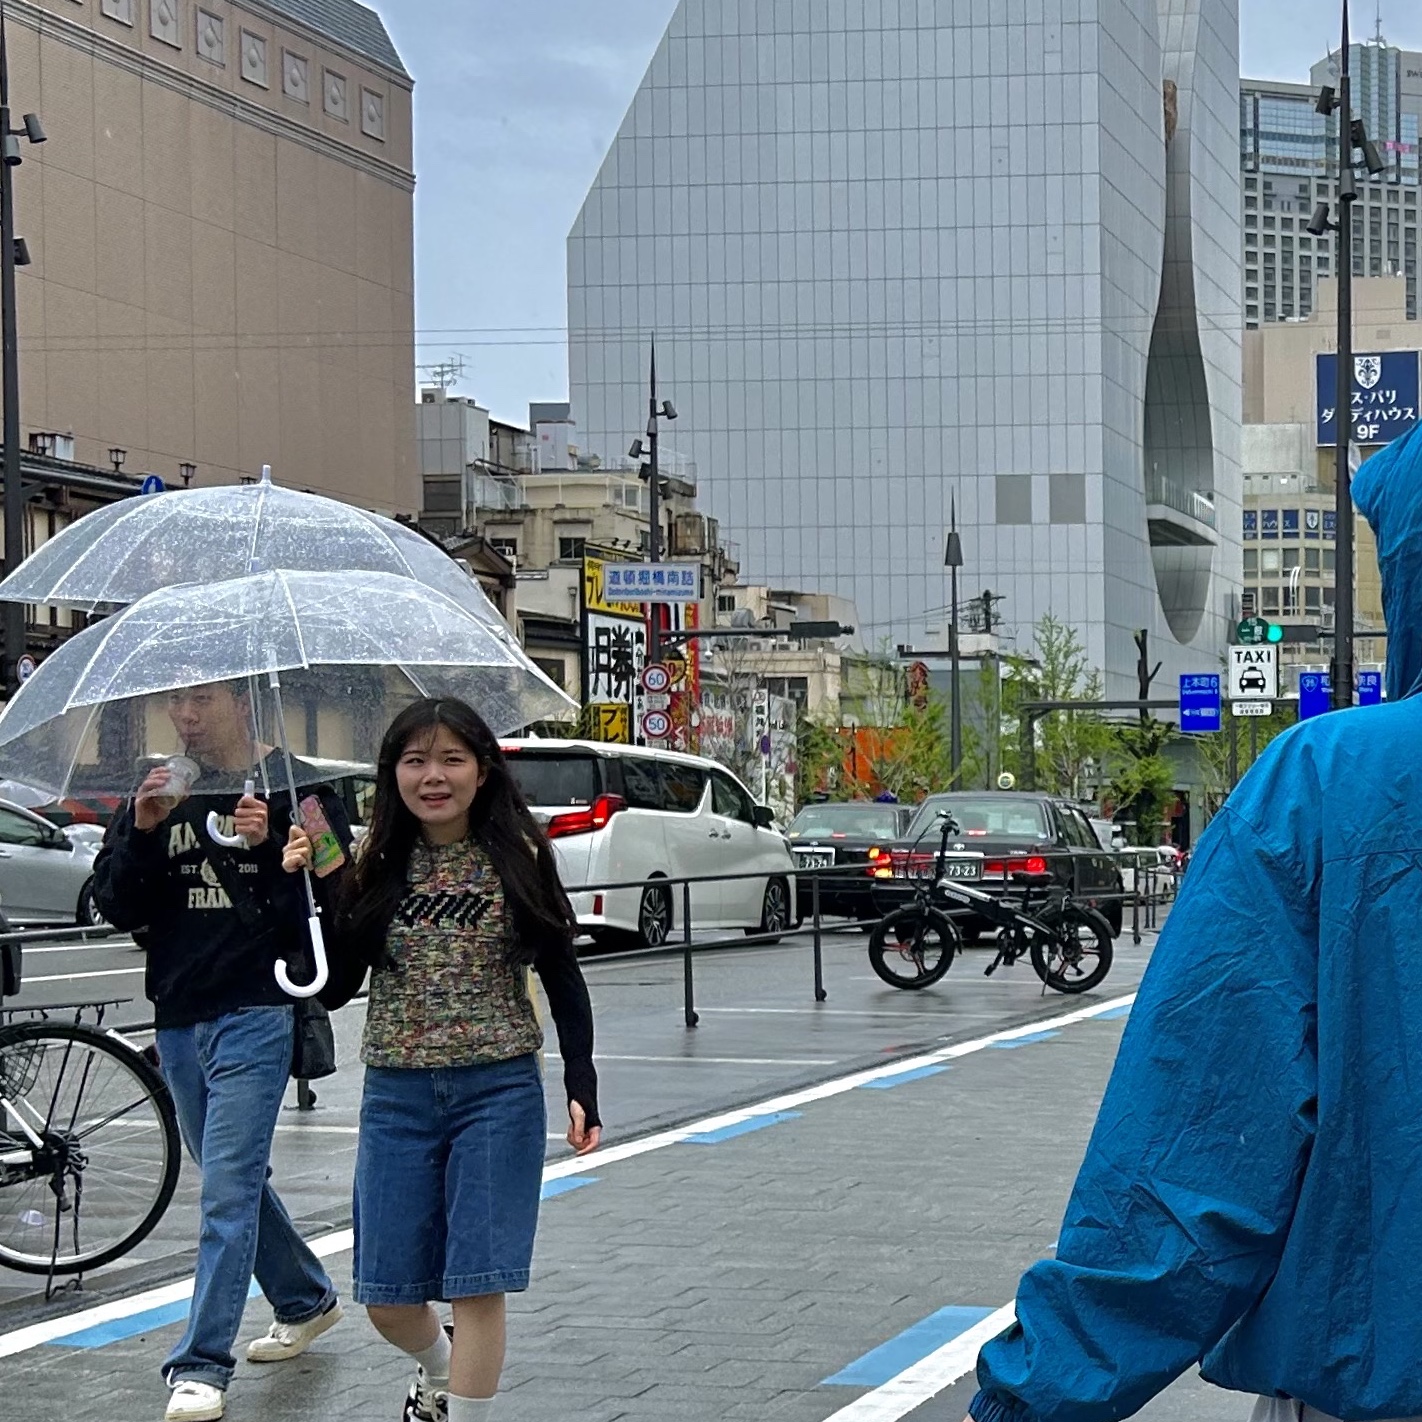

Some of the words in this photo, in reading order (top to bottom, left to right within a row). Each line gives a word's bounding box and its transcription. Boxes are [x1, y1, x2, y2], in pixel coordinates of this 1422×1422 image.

[1350, 389, 1397, 405] ス・パリ
[1322, 406, 1416, 424] ダディハウス
[1356, 424, 1381, 439] 9F
[608, 570, 694, 586] 道頓堀橋南詰
[1234, 650, 1271, 664] TAXI
[648, 673, 665, 686] 60
[648, 718, 665, 731] 50
[181, 864, 200, 875] EST.
